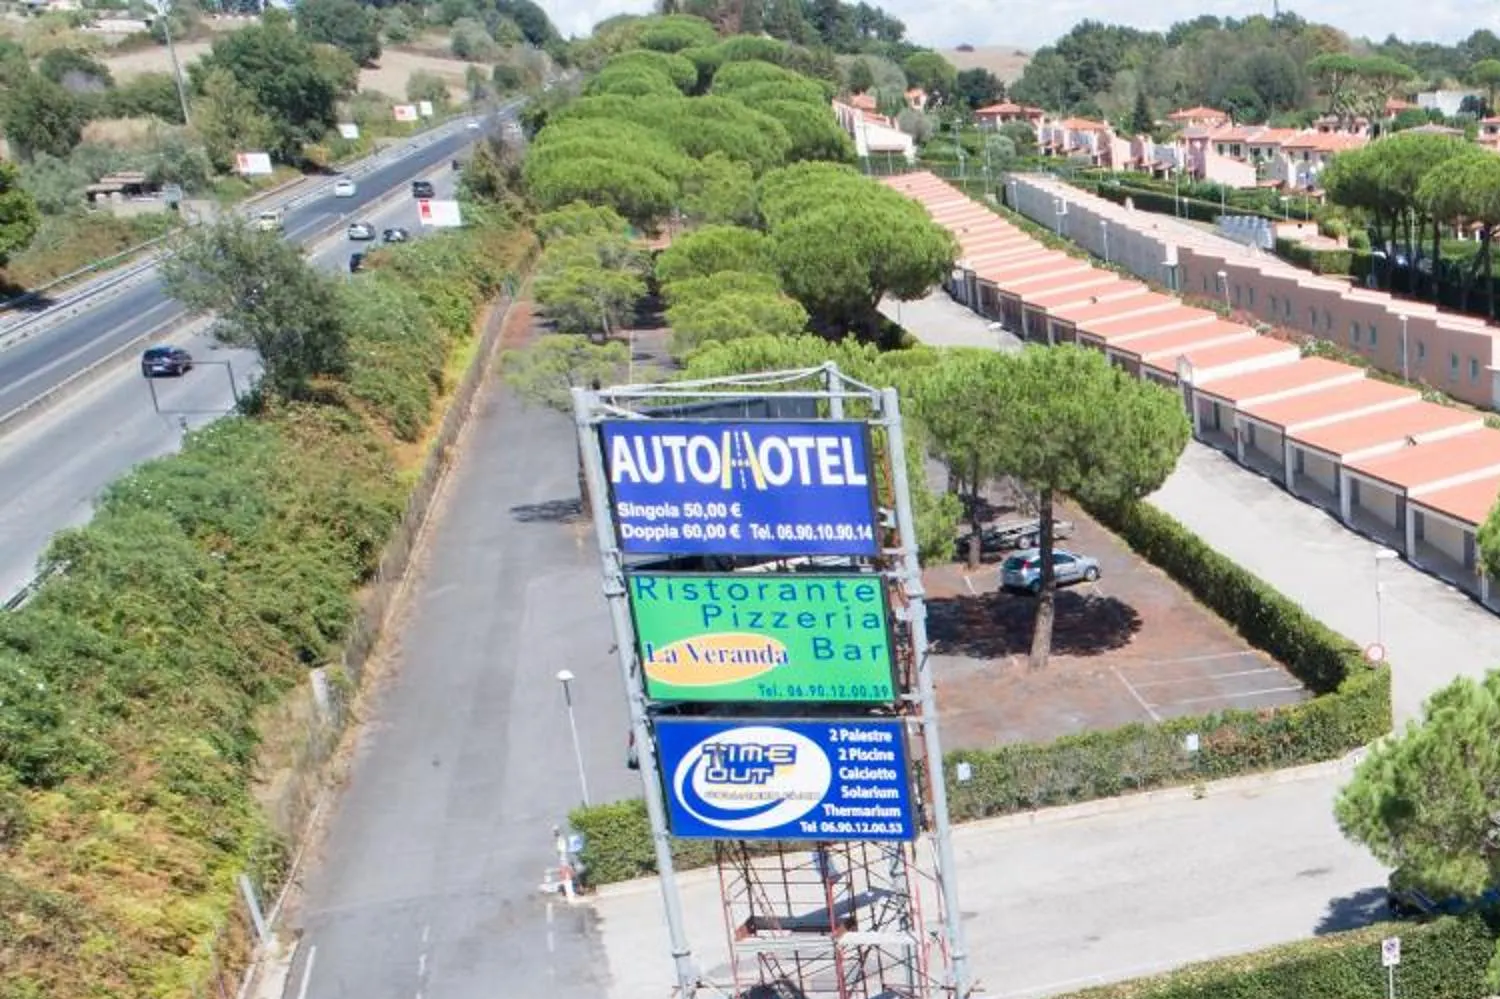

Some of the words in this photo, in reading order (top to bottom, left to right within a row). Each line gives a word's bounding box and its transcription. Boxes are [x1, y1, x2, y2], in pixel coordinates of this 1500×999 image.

[612, 430, 867, 490] AUTOHOTEL
[618, 503, 679, 520] Singola
[683, 503, 726, 518] 50,00
[731, 503, 741, 516] €
[621, 523, 679, 540] Doppia
[683, 523, 726, 540] 60,00
[730, 524, 740, 538] €
[636, 576, 875, 601] Ristorante
[702, 604, 880, 629] Pizzeria
[646, 643, 677, 664] La
[688, 643, 789, 665] Veranda
[812, 637, 882, 661] Bar
[829, 729, 839, 742] 2
[840, 729, 892, 742] Palestre
[702, 743, 798, 768] TIME
[838, 748, 848, 761] 2
[849, 747, 894, 761] Piscine
[705, 766, 775, 784] OUT
[841, 786, 899, 799] Solarium
[822, 804, 901, 817] Thermarium
